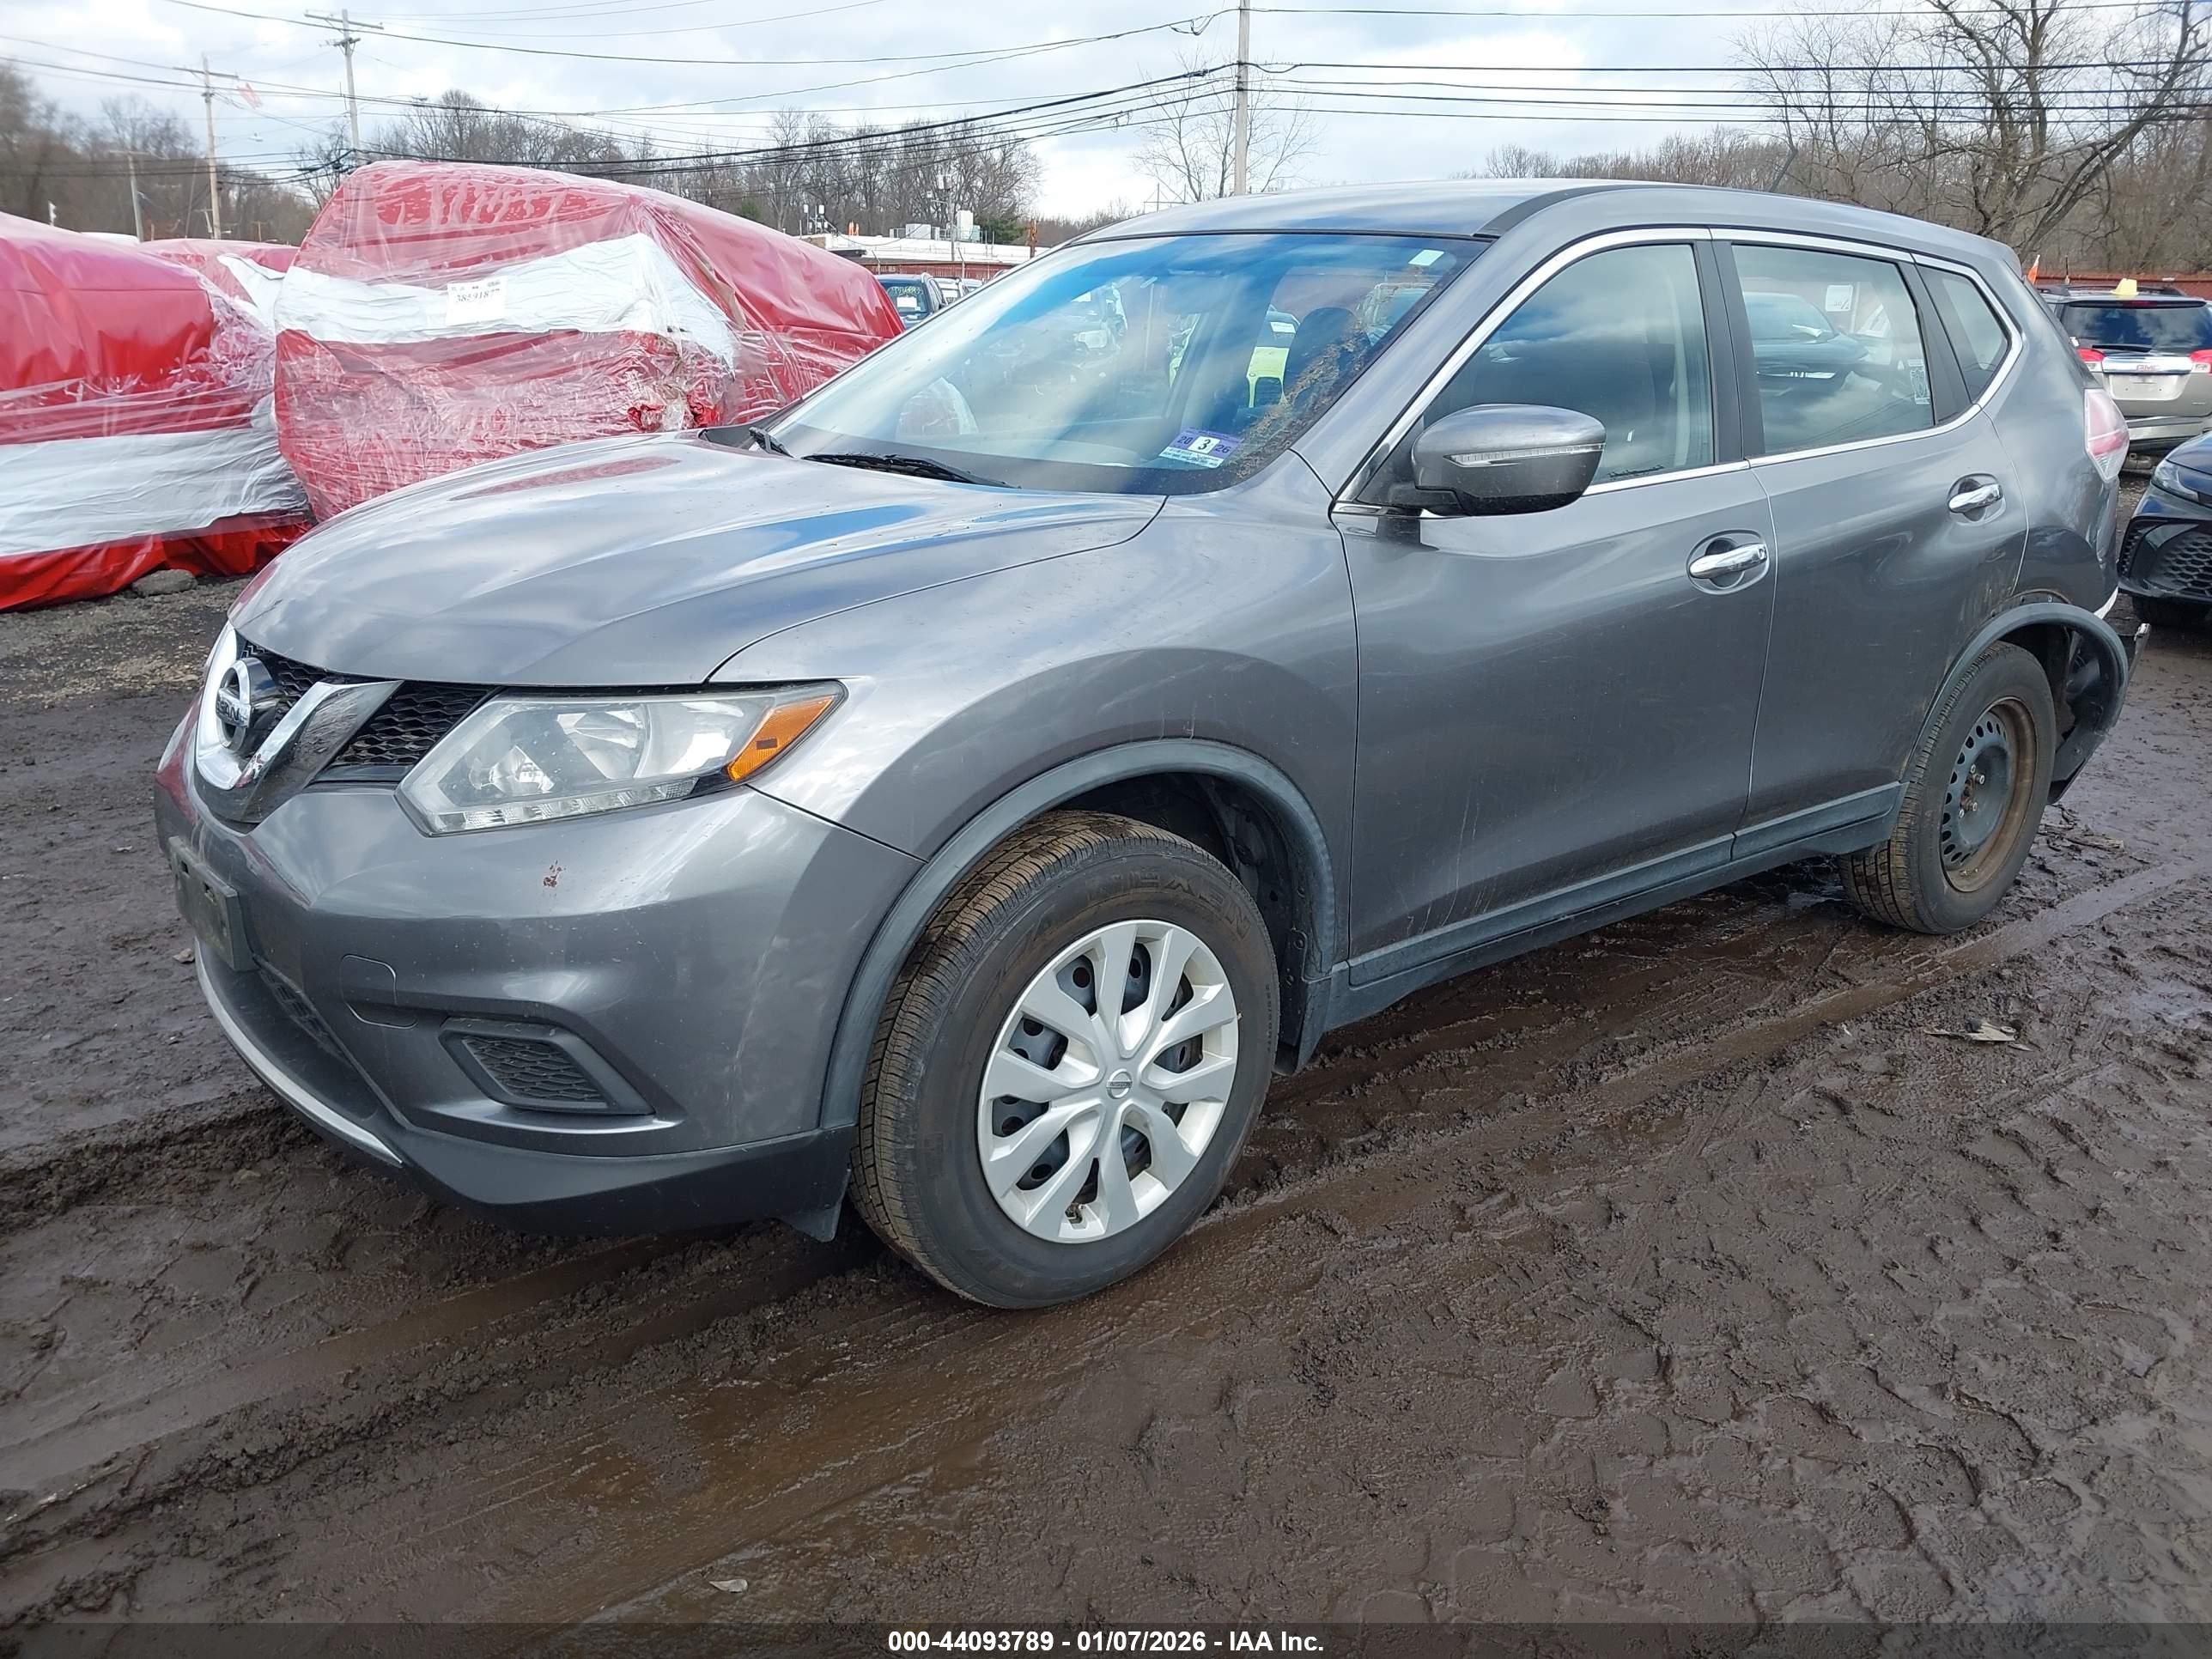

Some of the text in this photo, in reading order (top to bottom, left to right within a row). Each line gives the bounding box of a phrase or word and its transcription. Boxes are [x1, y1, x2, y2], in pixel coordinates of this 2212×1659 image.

[1177, 435, 1231, 453] 20 3 26
